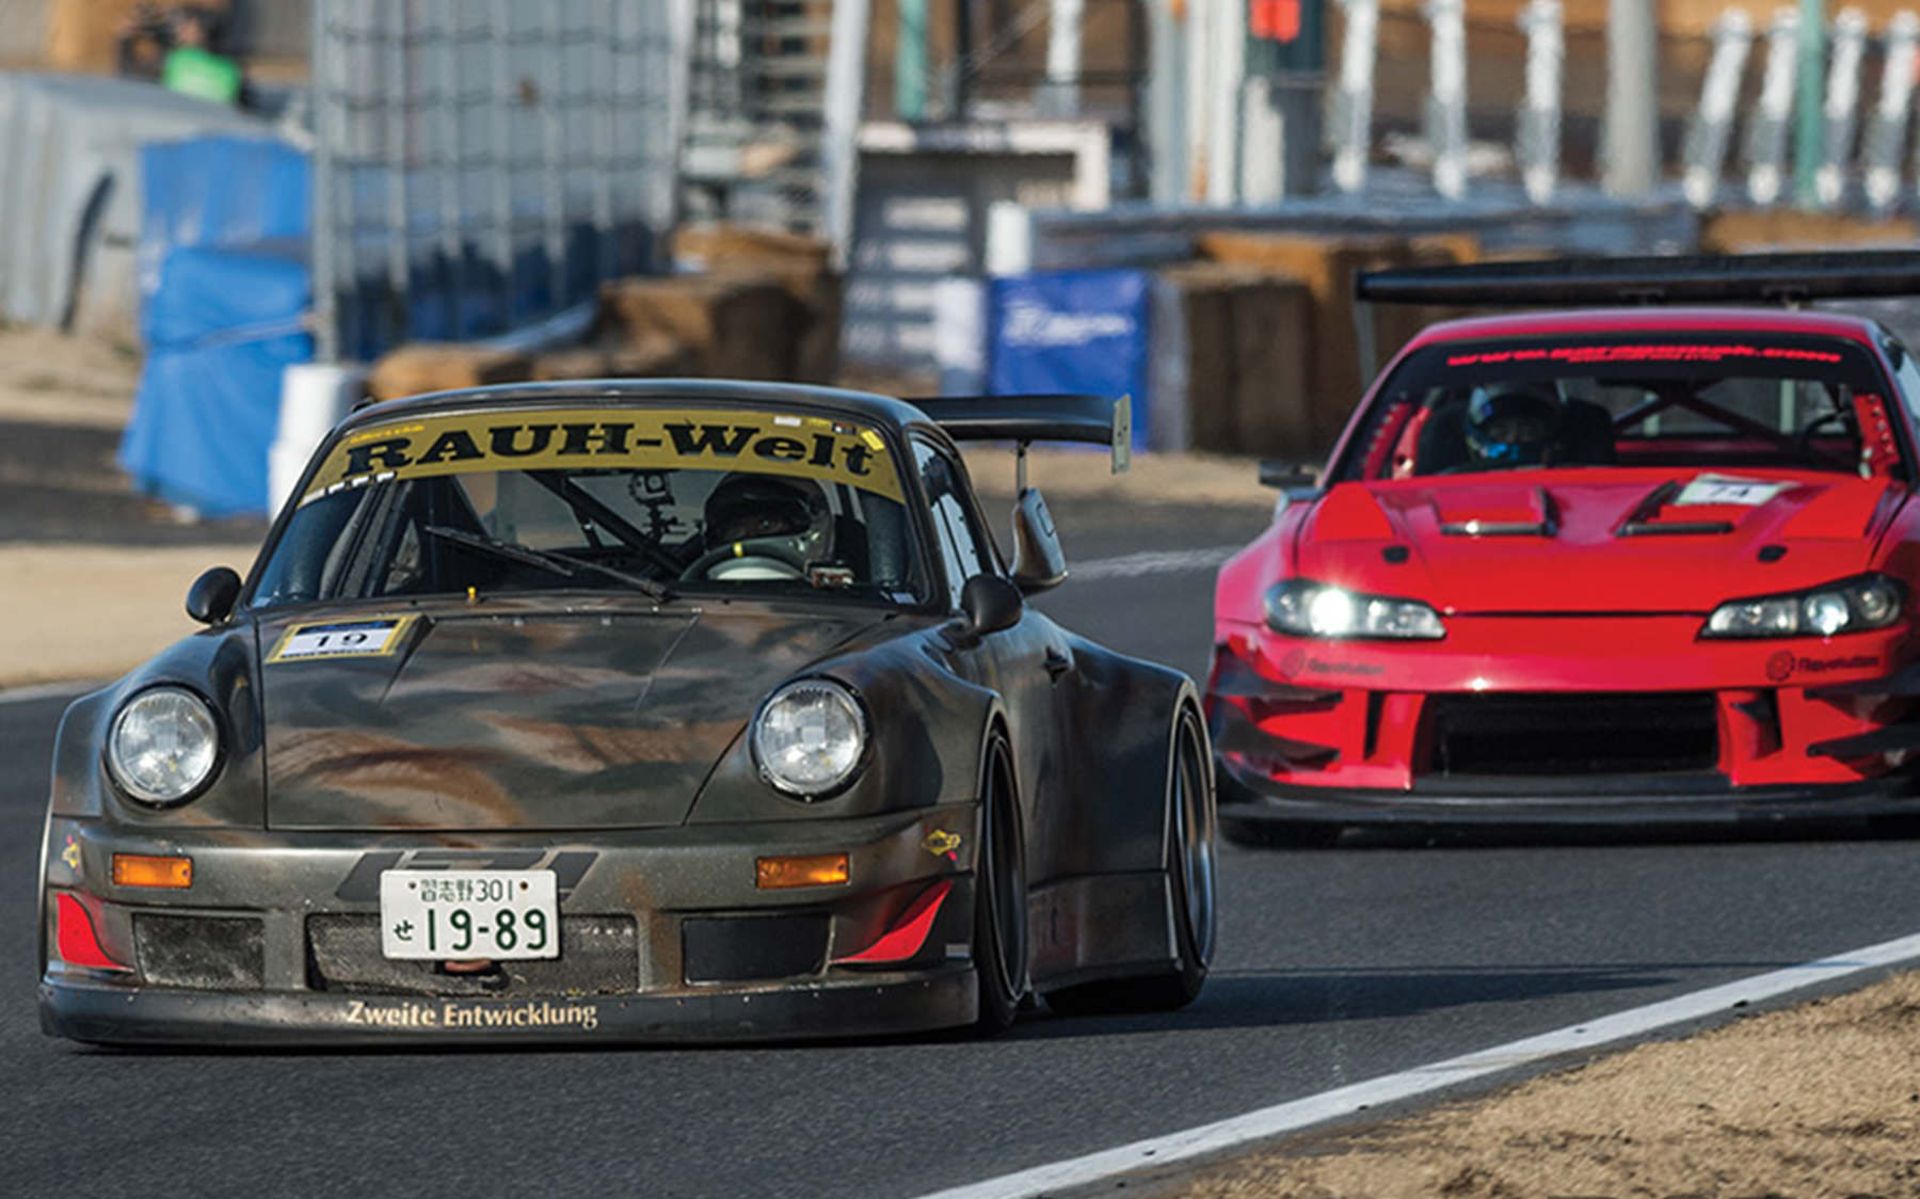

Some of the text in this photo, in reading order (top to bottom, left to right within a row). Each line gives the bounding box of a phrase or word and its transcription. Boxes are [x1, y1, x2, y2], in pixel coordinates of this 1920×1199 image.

[342, 421, 873, 477] RAUH-Welt
[317, 633, 368, 649] 19
[393, 908, 548, 951] せ 19-89
[347, 1001, 598, 1030] Zweite Entwicklung
